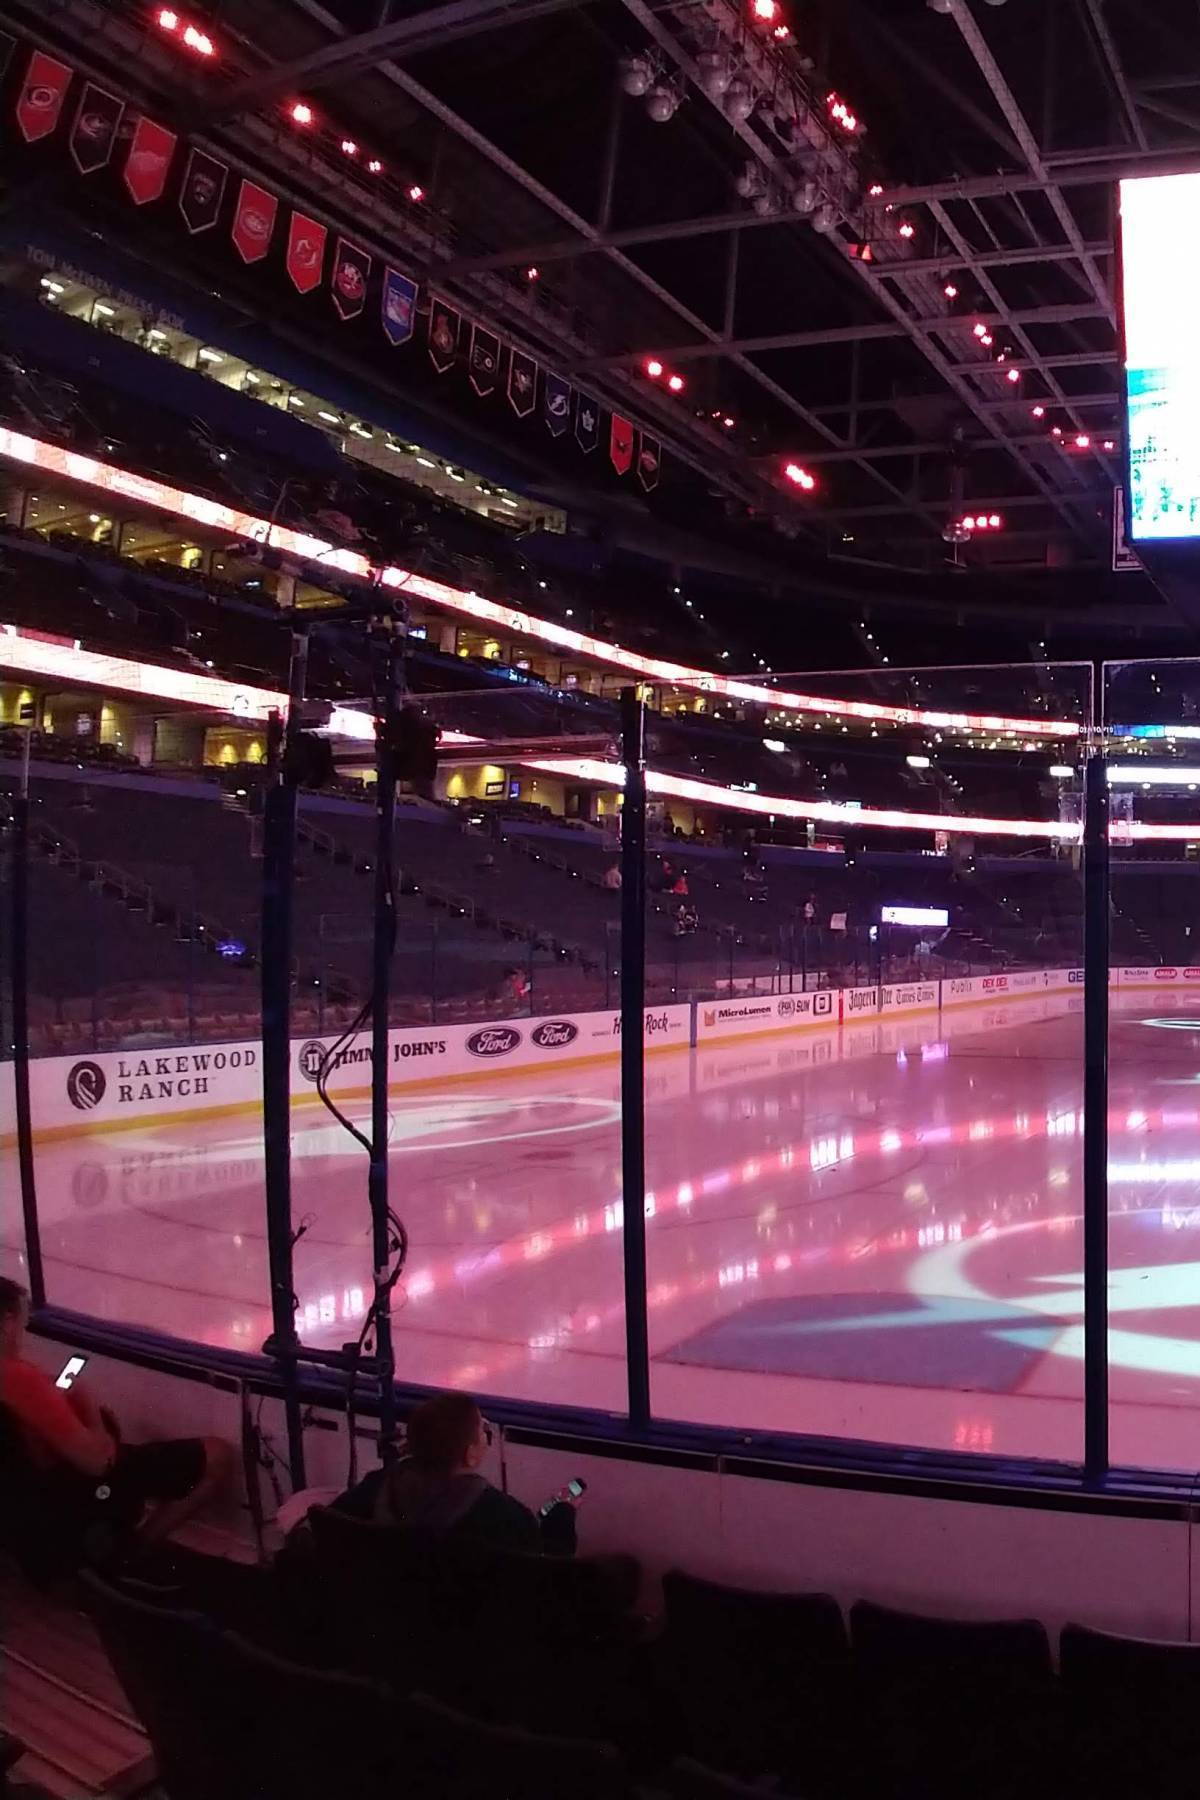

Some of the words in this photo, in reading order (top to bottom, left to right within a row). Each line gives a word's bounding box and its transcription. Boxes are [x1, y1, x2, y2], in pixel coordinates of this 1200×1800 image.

[645, 1012, 669, 1034] Rock
[718, 1006, 772, 1018] MicroLumen
[393, 1041, 447, 1062] JOHN'S
[117, 1049, 256, 1078] LAKEWOOD
[118, 1077, 209, 1102] RANCH
